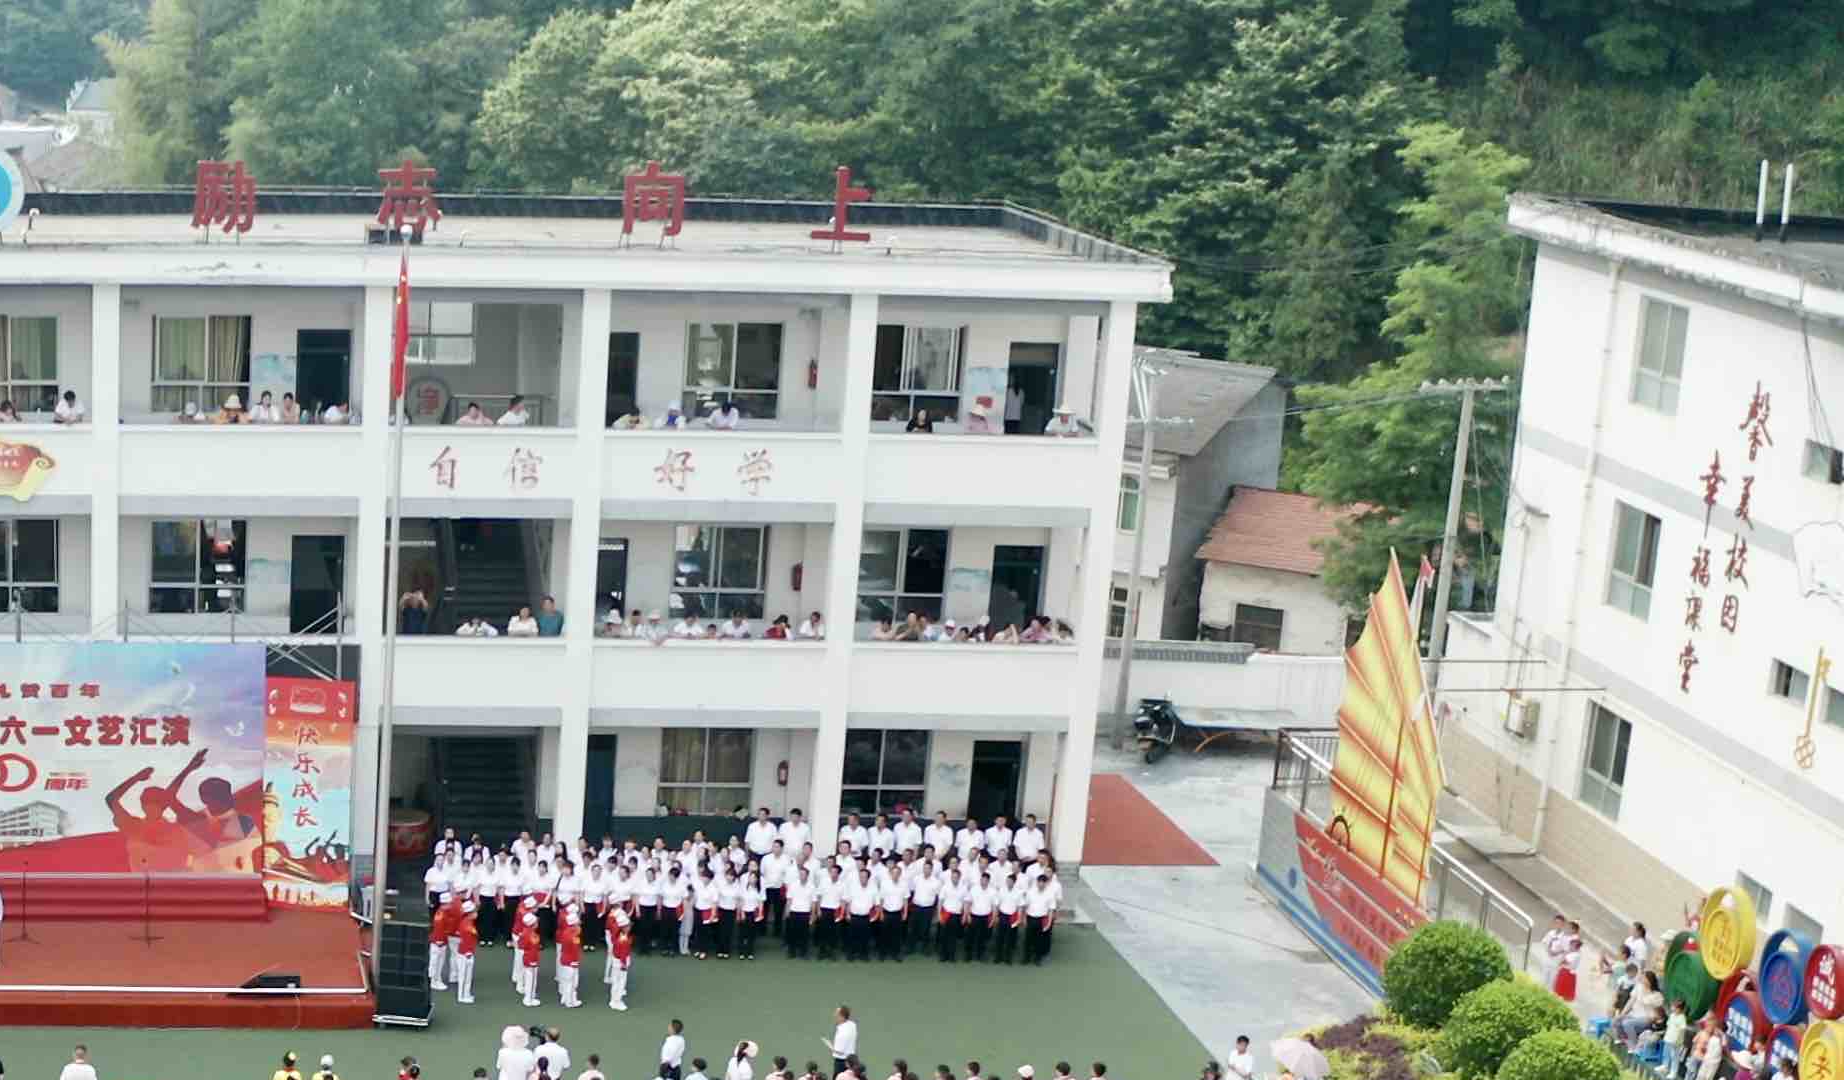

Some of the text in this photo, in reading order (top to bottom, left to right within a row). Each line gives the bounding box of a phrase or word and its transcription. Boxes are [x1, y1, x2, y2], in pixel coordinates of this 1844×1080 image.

[190, 158, 872, 242] 励志向上
[292, 725, 320, 827] 快乐成长
